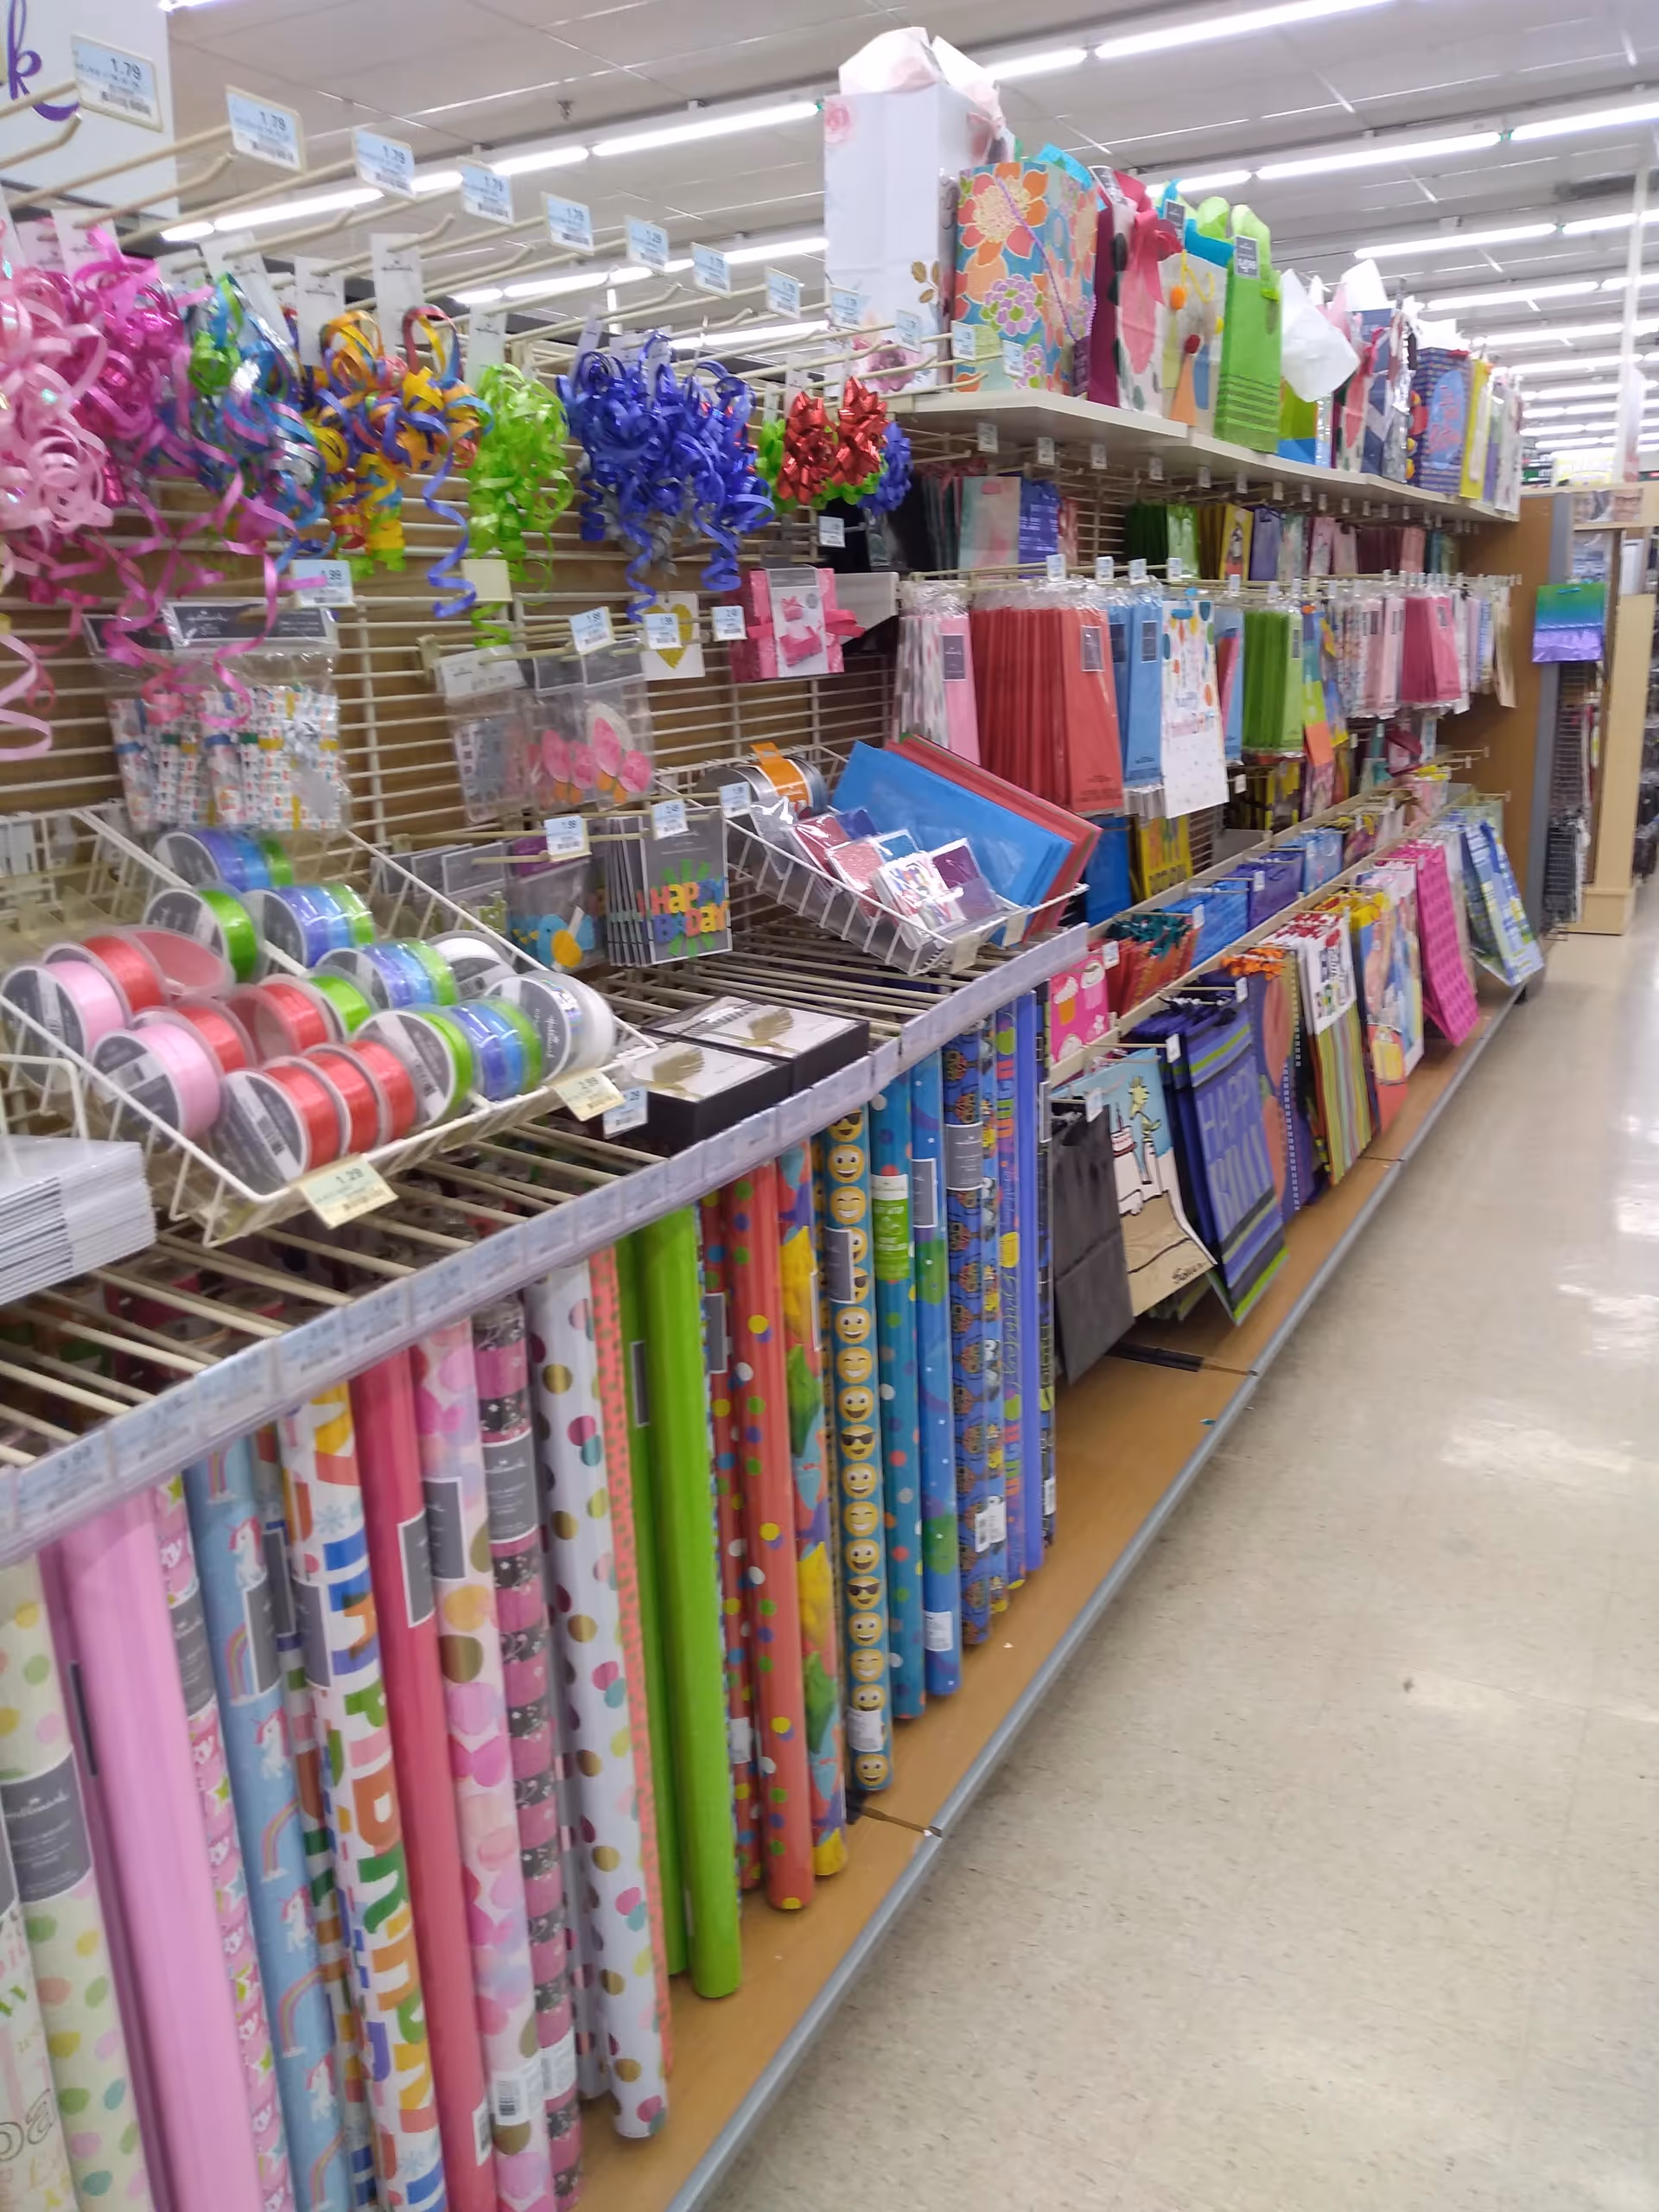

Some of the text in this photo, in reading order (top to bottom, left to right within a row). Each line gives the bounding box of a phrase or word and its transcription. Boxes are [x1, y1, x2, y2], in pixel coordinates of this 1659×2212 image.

[110, 57, 142, 81] 1.79
[259, 110, 286, 130] 1.79
[382, 145, 406, 165] 1.79
[484, 175, 505, 193] 1.79
